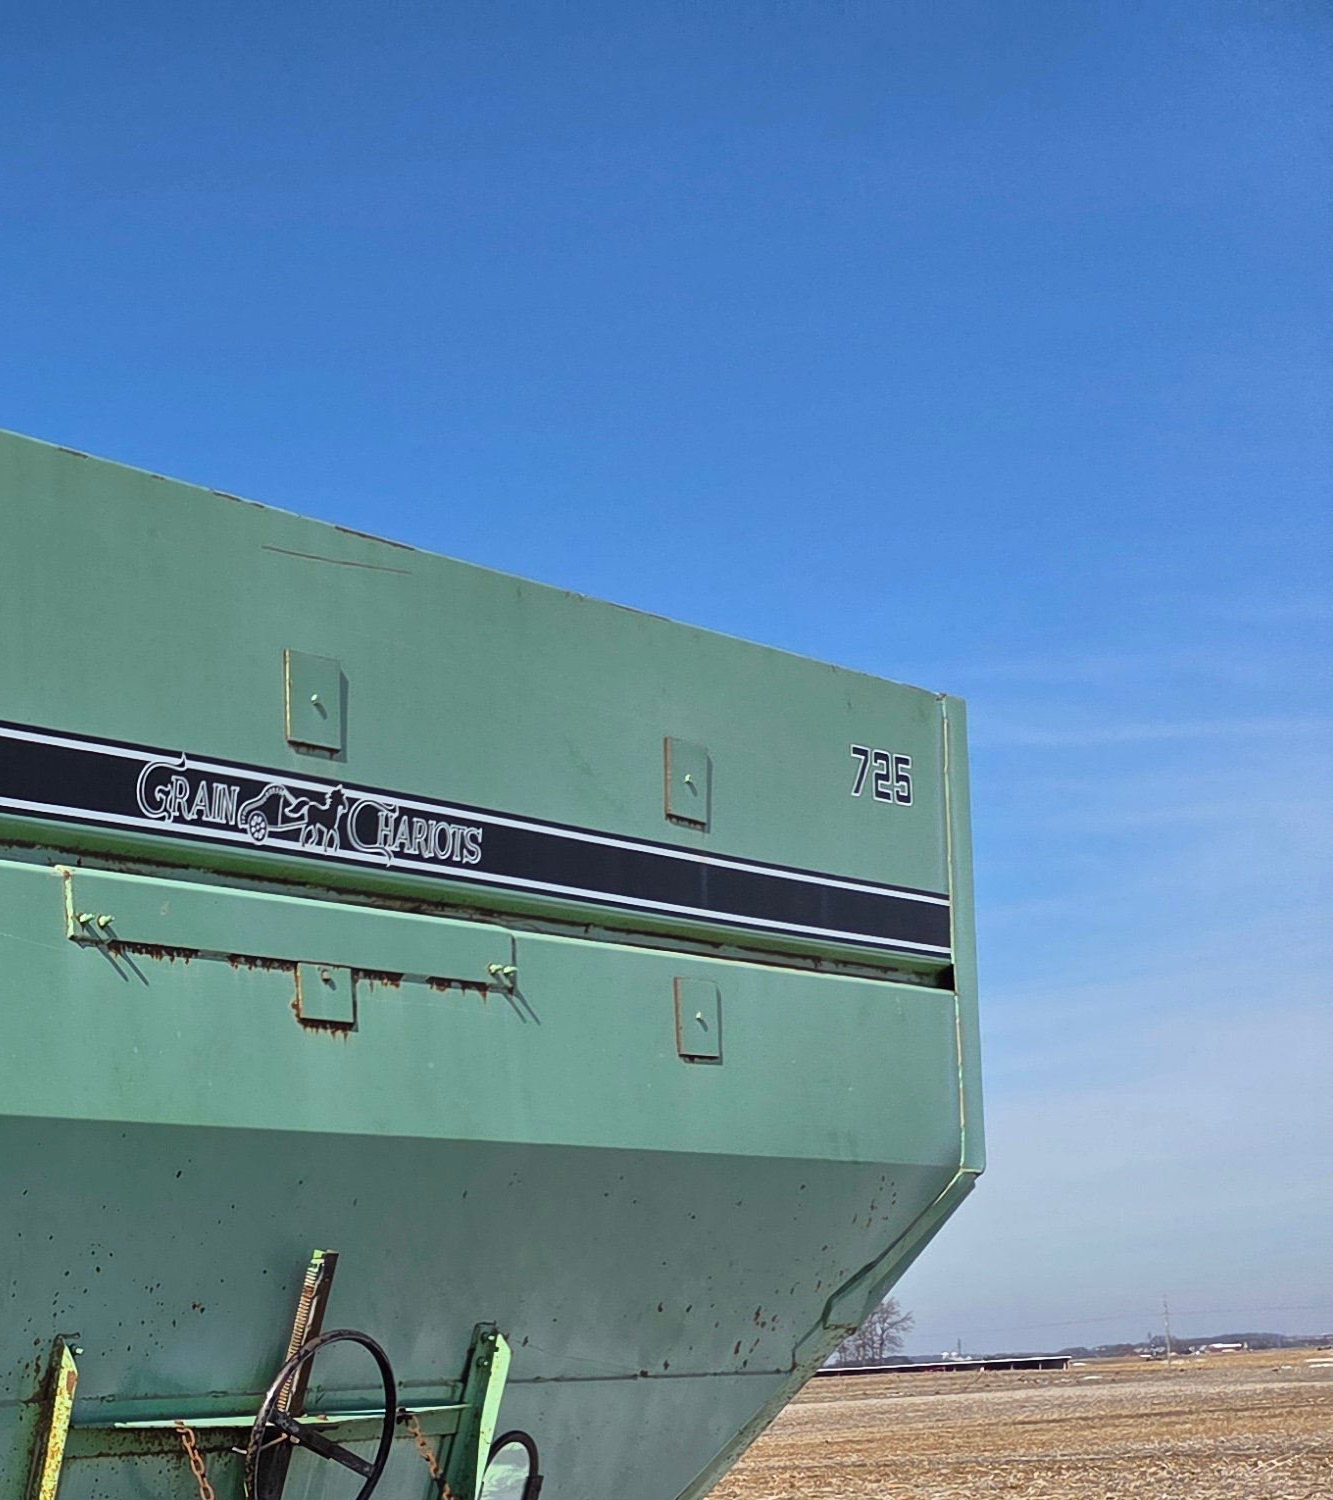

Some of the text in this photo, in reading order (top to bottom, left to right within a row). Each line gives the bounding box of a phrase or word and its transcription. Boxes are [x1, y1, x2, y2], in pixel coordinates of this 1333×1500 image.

[136, 752, 483, 867] GRAIN CHARIOTS
[850, 743, 913, 807] 725
